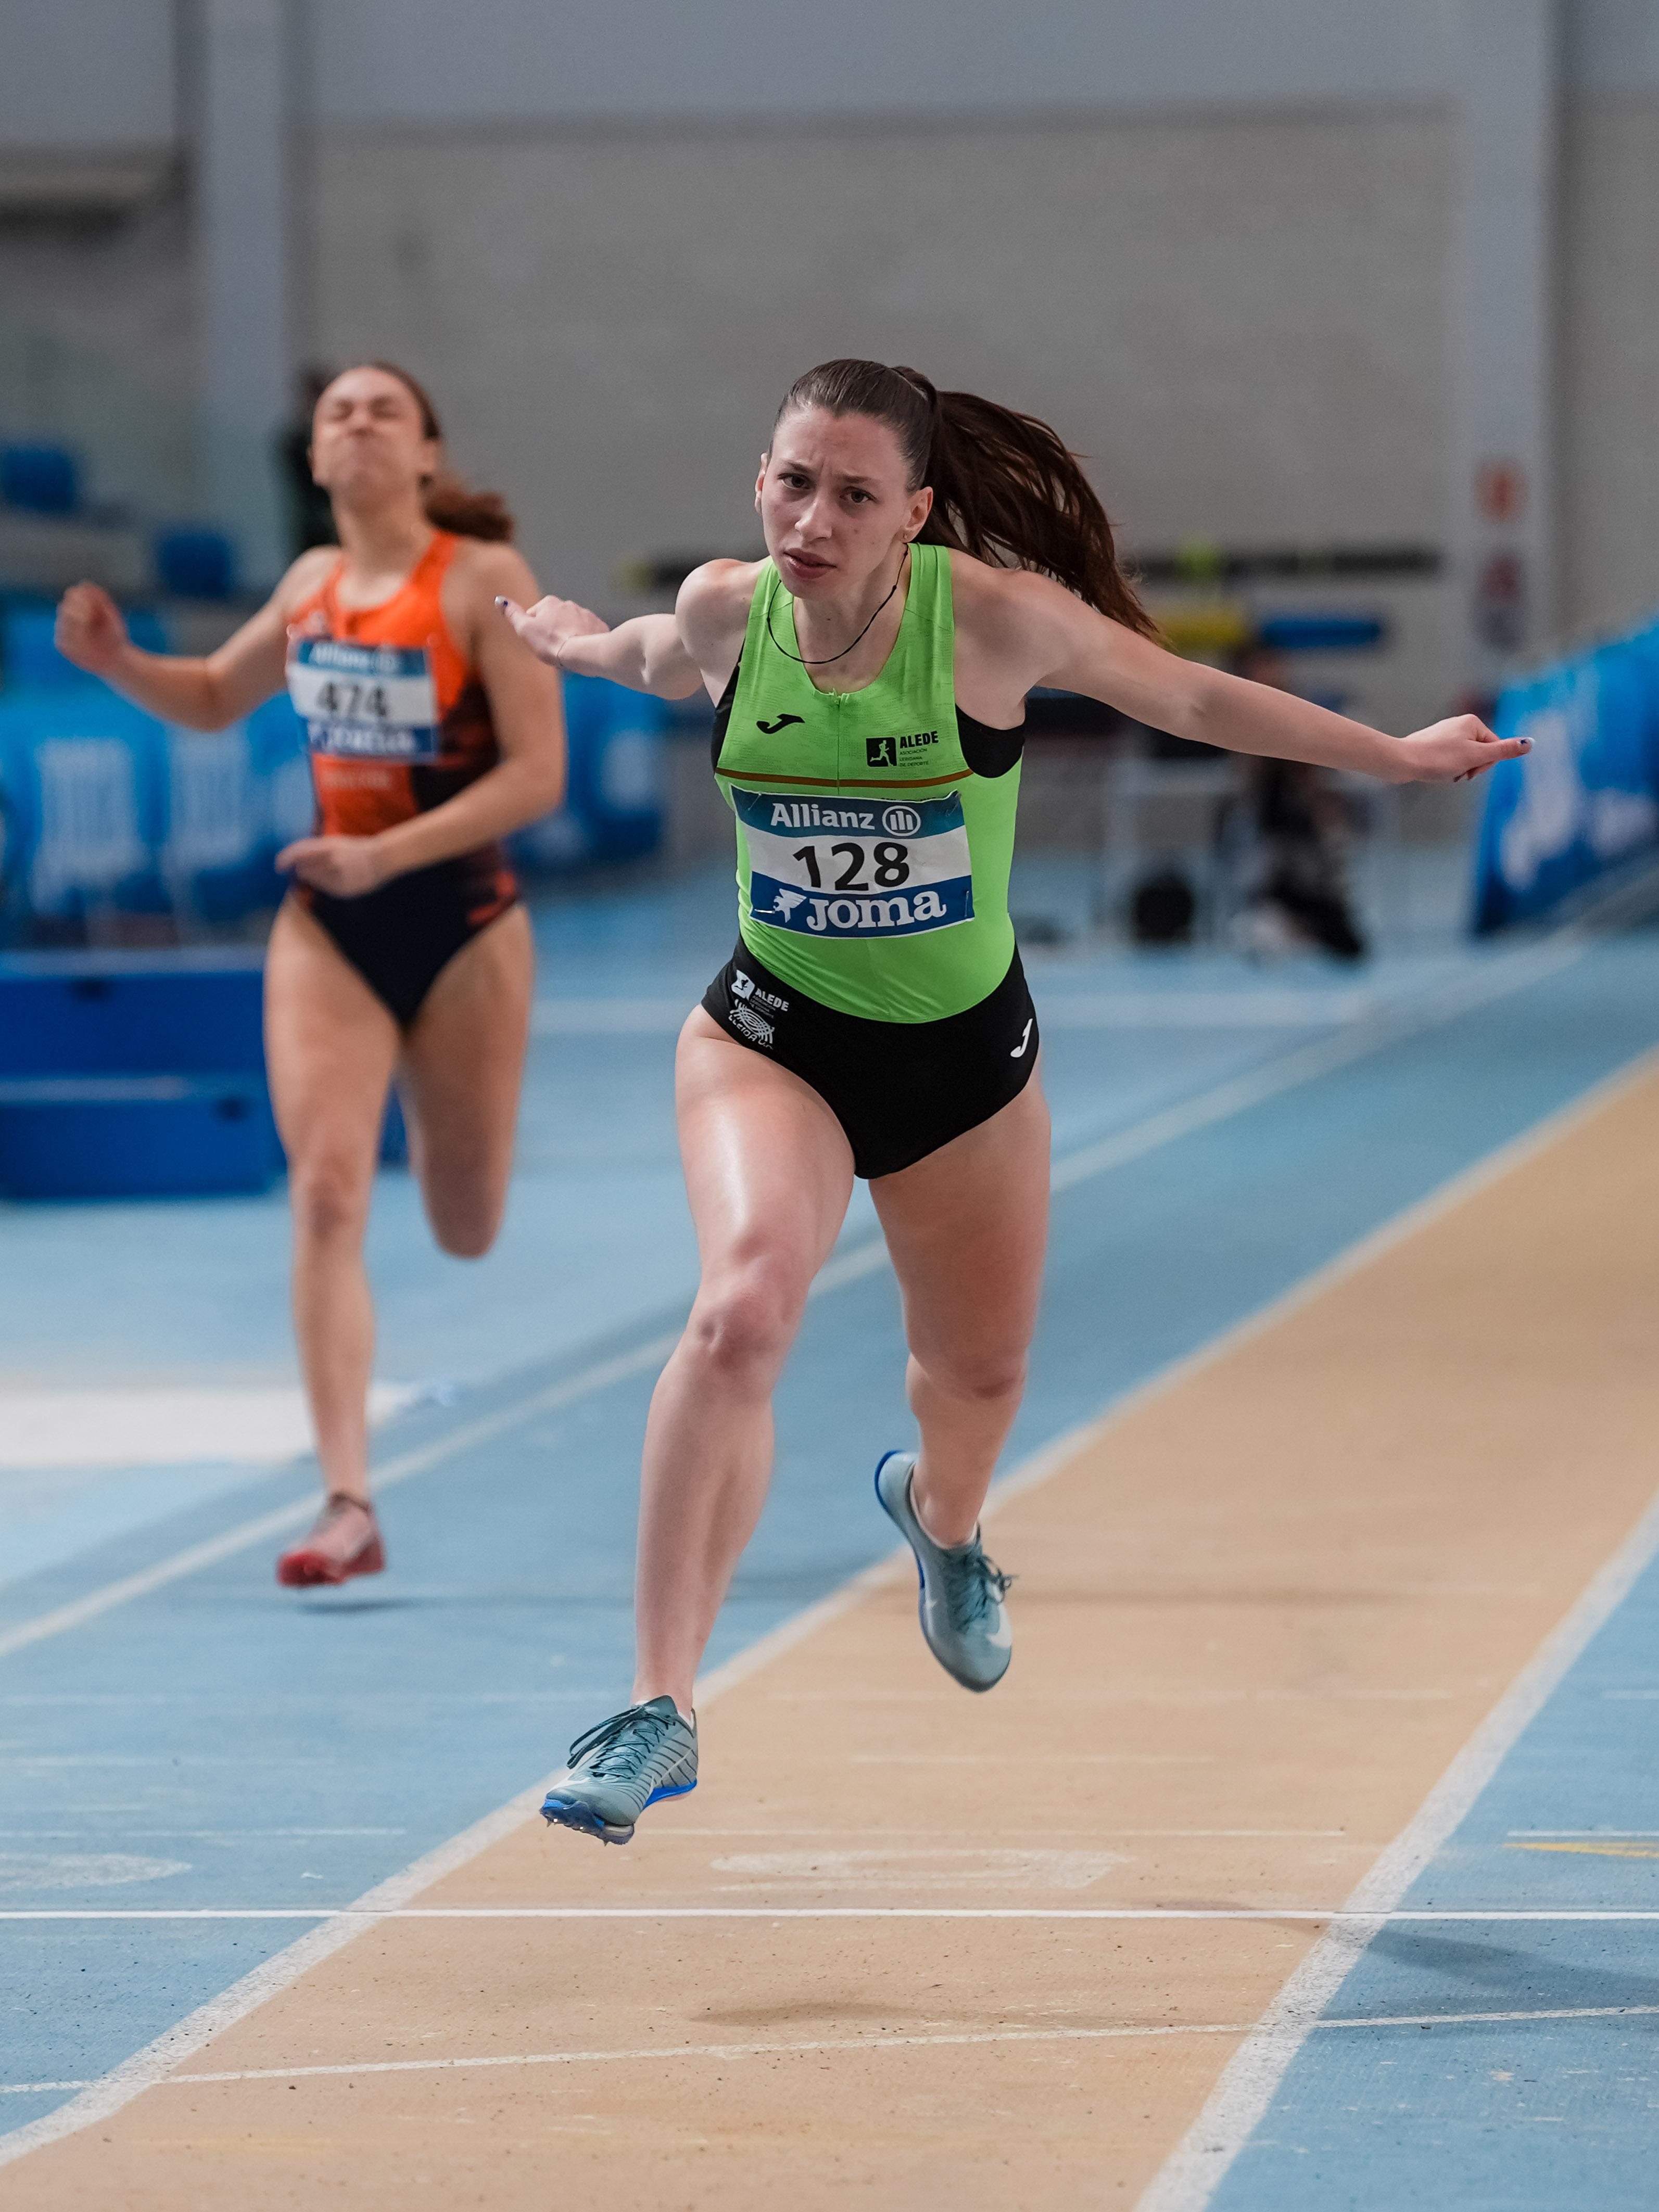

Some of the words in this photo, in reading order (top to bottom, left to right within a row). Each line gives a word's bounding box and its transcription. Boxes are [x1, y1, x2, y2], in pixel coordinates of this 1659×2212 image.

[316, 681, 387, 718] 474
[900, 731, 939, 748] ALEDE
[770, 803, 876, 830] Allianz
[793, 842, 910, 891] 128
[755, 988, 790, 1012] ALEDE
